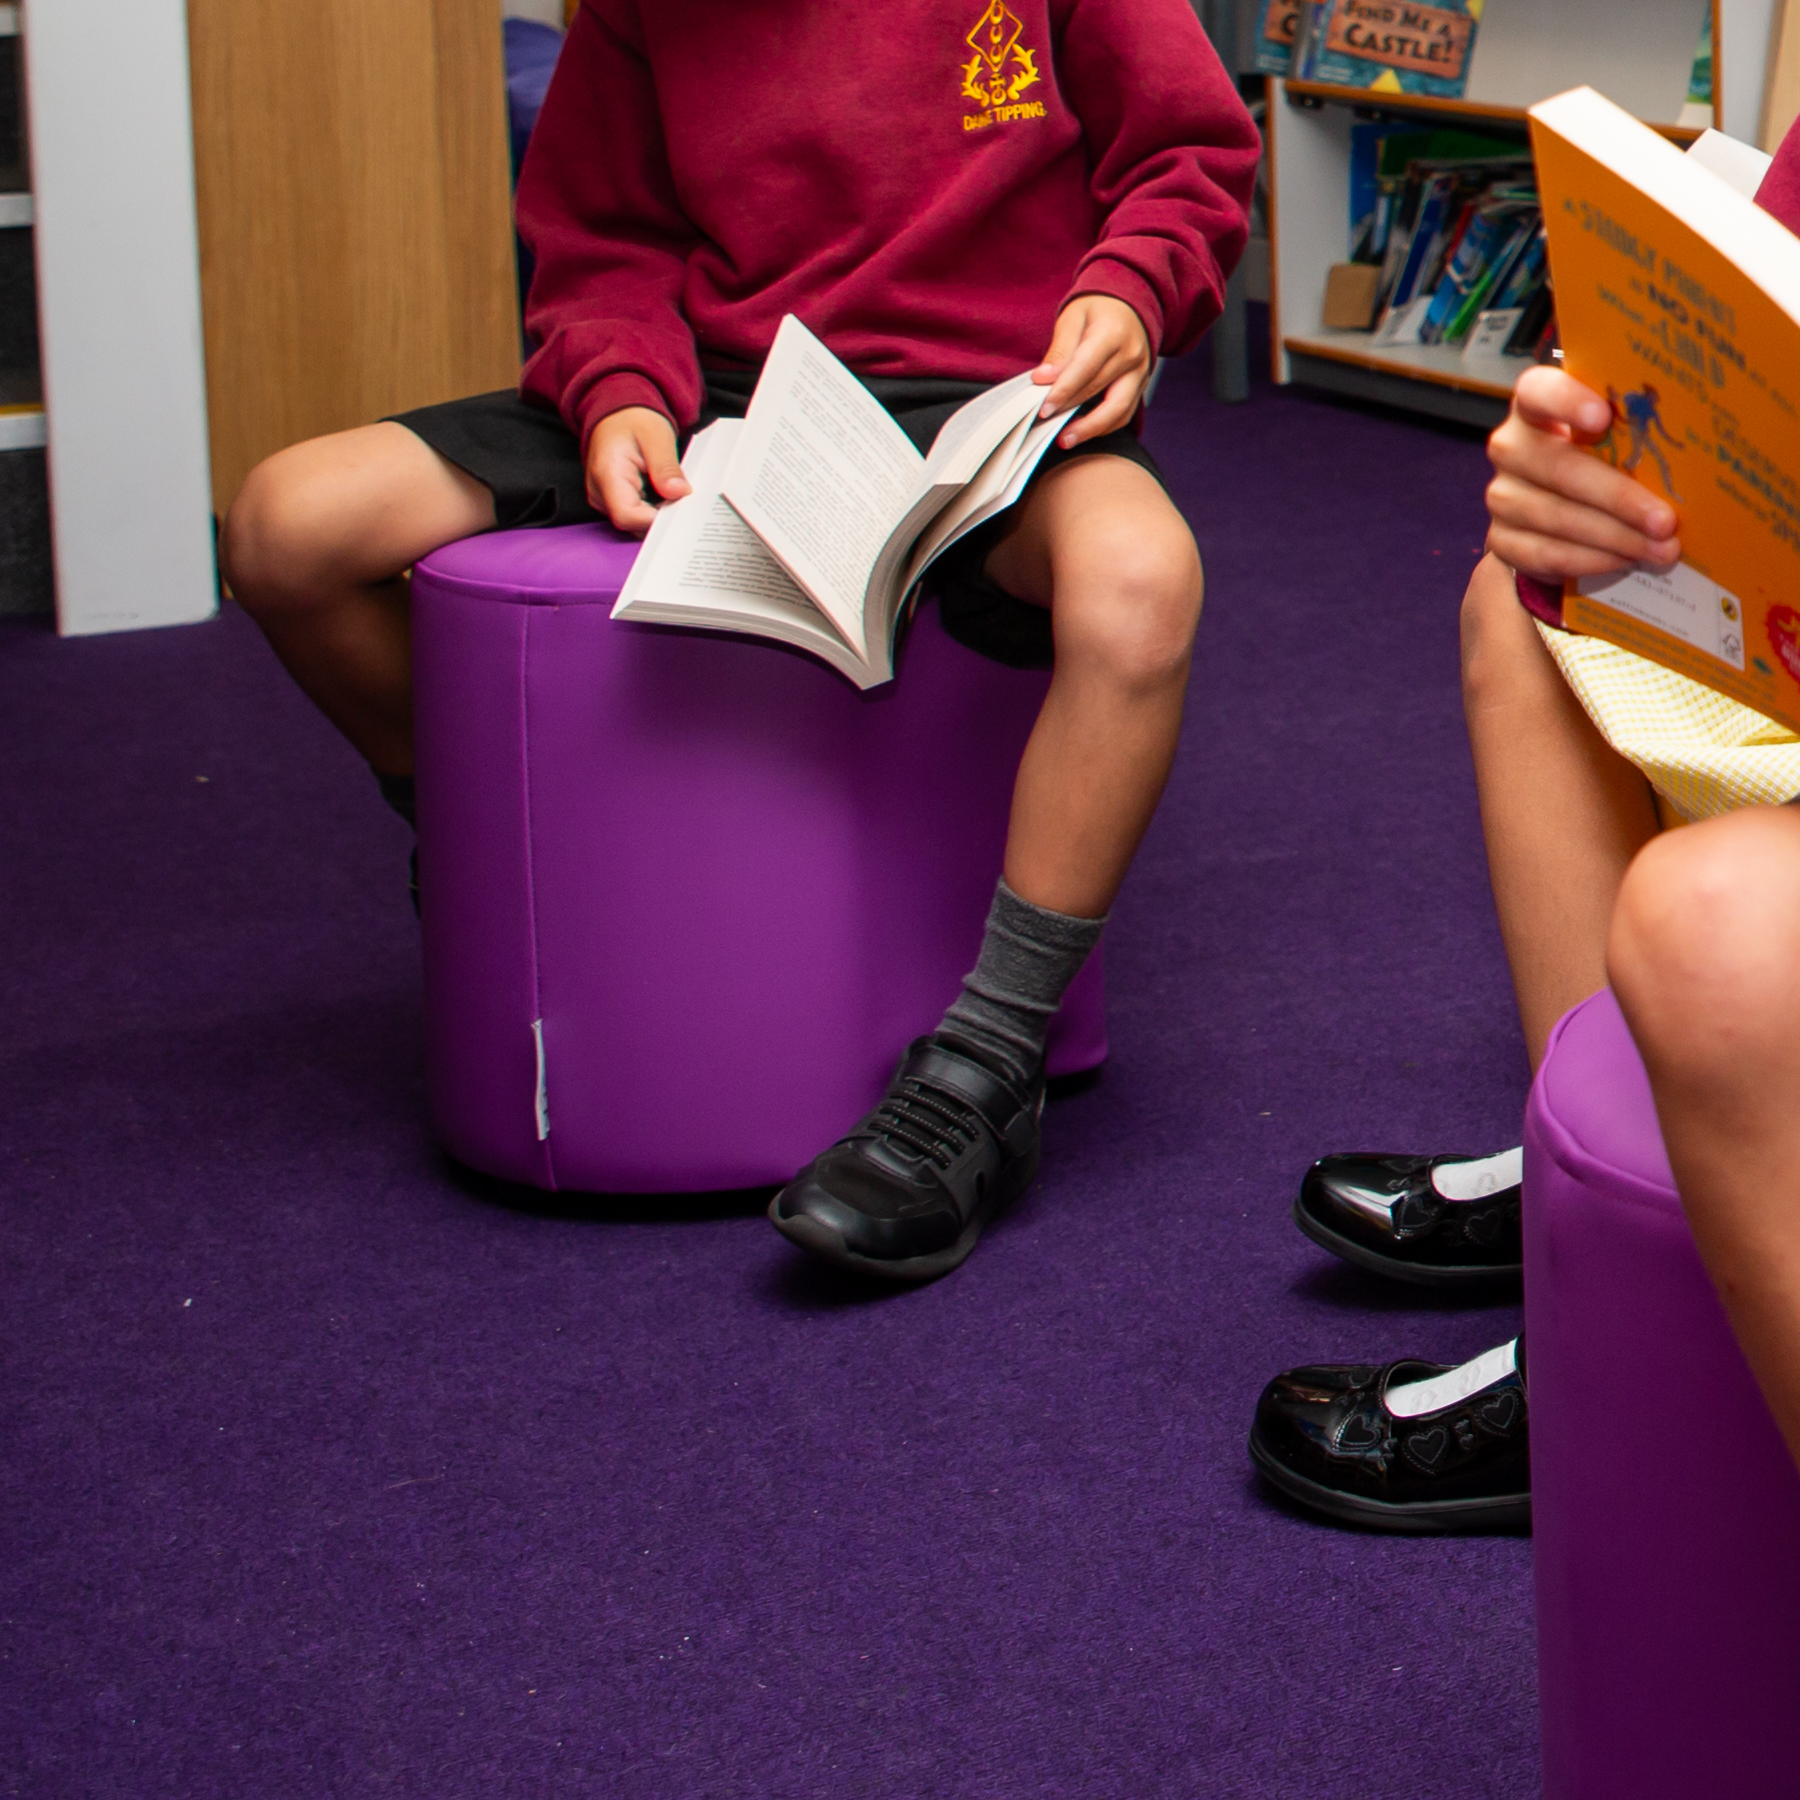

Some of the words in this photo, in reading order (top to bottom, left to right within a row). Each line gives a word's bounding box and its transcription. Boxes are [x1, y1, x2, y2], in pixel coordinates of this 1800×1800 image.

[1344, 0, 1395, 24] FIND
[1435, 21, 1452, 36] A
[1343, 22, 1454, 64] CASTLE!
[962, 109, 993, 131] DAME
[993, 100, 1047, 123] TIPPING
